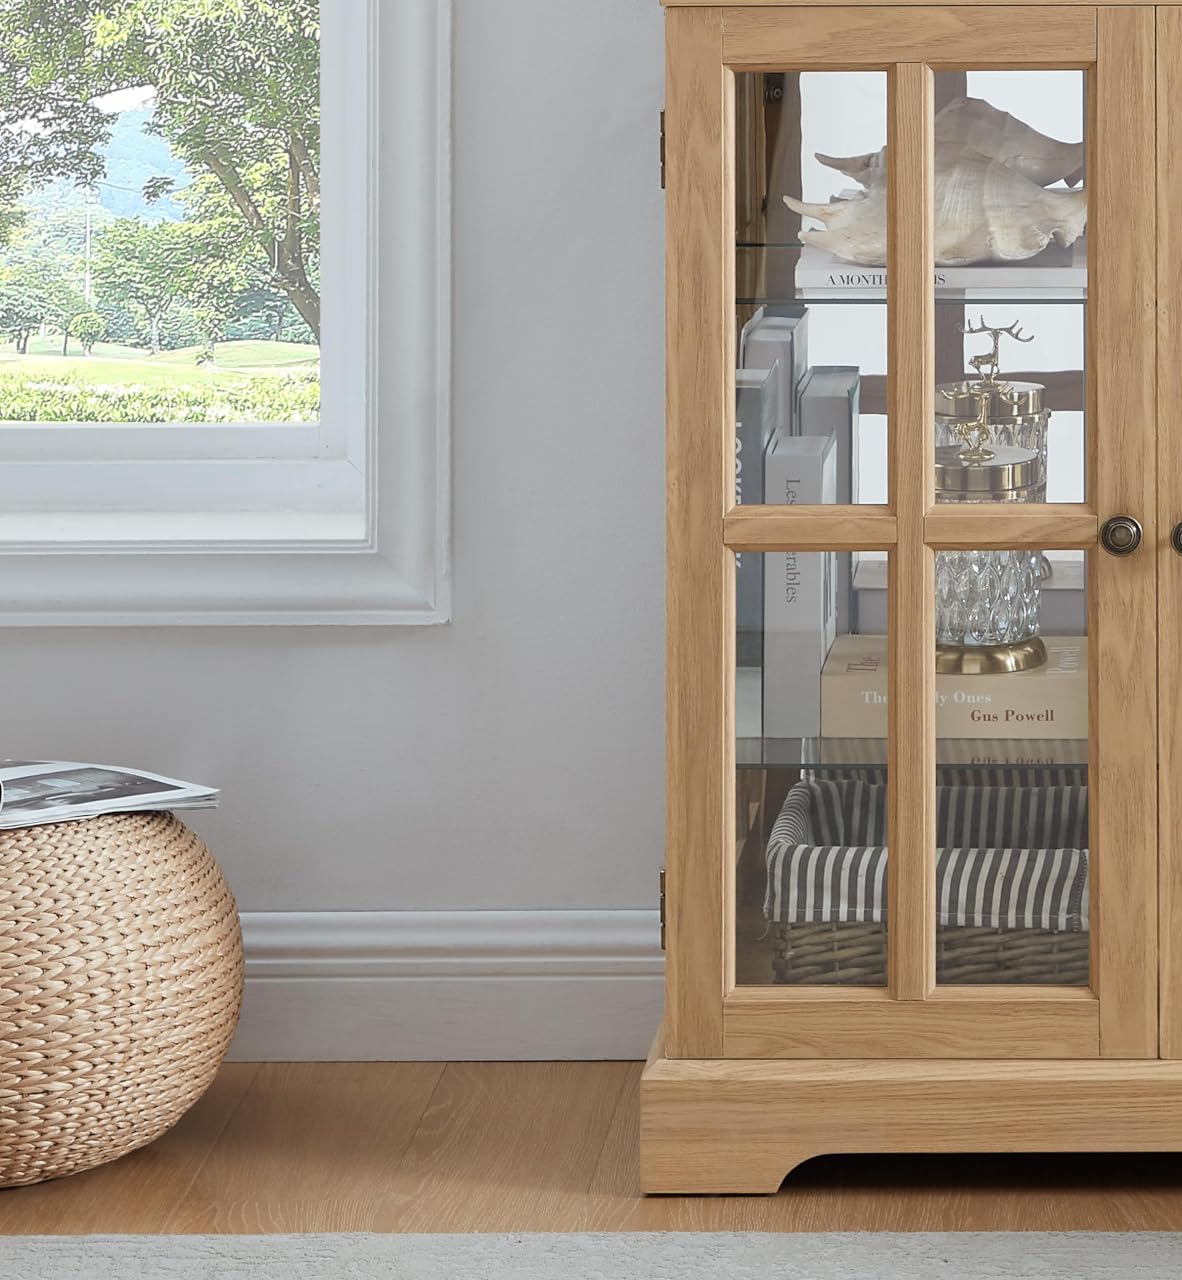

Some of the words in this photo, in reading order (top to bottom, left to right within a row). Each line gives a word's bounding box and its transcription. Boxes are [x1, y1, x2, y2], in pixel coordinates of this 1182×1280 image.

[826, 274, 836, 285] A
[785, 479, 801, 504] Les
[953, 691, 992, 704] Ones
[970, 709, 999, 722] Gus
[1005, 709, 1056, 722] Powell
